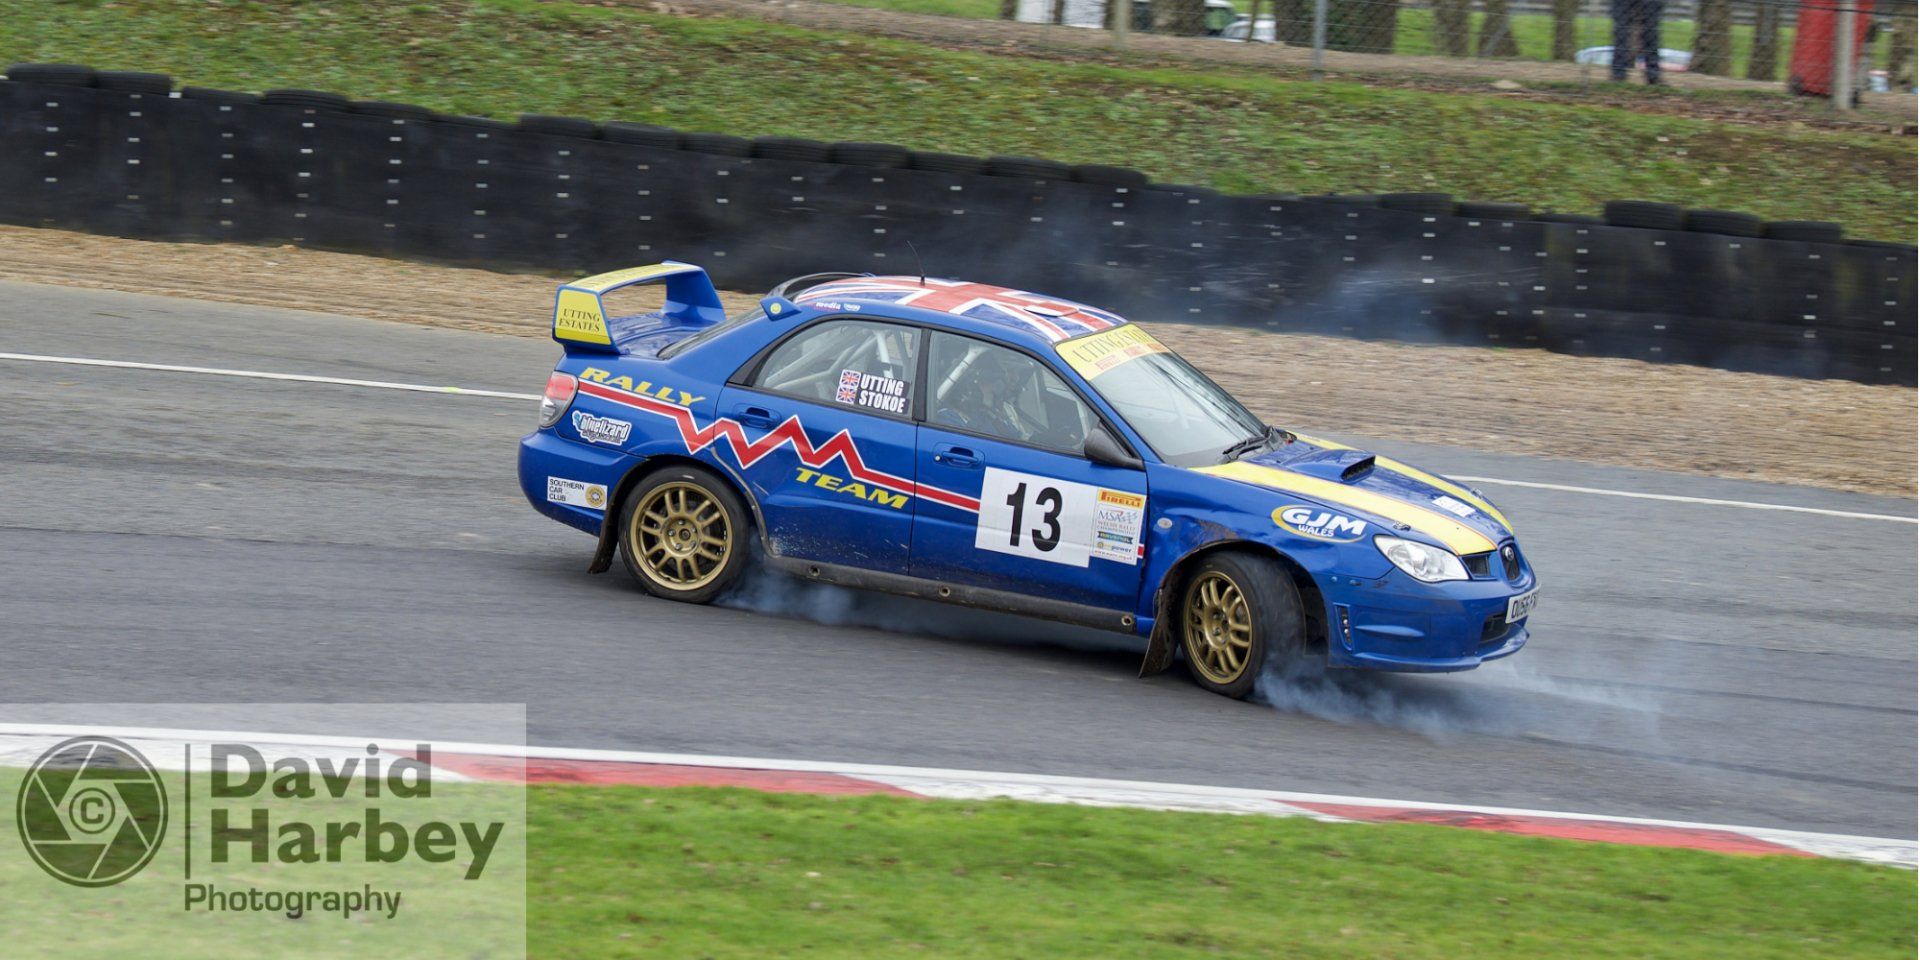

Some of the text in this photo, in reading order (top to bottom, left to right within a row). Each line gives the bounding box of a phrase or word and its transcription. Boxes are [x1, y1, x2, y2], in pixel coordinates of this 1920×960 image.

[563, 308, 601, 322] UTTING
[559, 318, 601, 332] ESTATES
[580, 367, 706, 407] RALLY
[860, 374, 904, 396] UTTING
[859, 390, 906, 413] STOKOE
[580, 415, 630, 439] bluelizard
[549, 479, 585, 491] SOUTHERN
[549, 486, 563, 494] CAR
[796, 467, 908, 509] TEAM
[549, 494, 567, 502] CLUB
[1101, 490, 1142, 508] PIRELLI
[1006, 482, 1063, 552] 13
[1282, 508, 1367, 535] GJM
[1298, 524, 1334, 537] WALES
[1111, 545, 1132, 553] power
